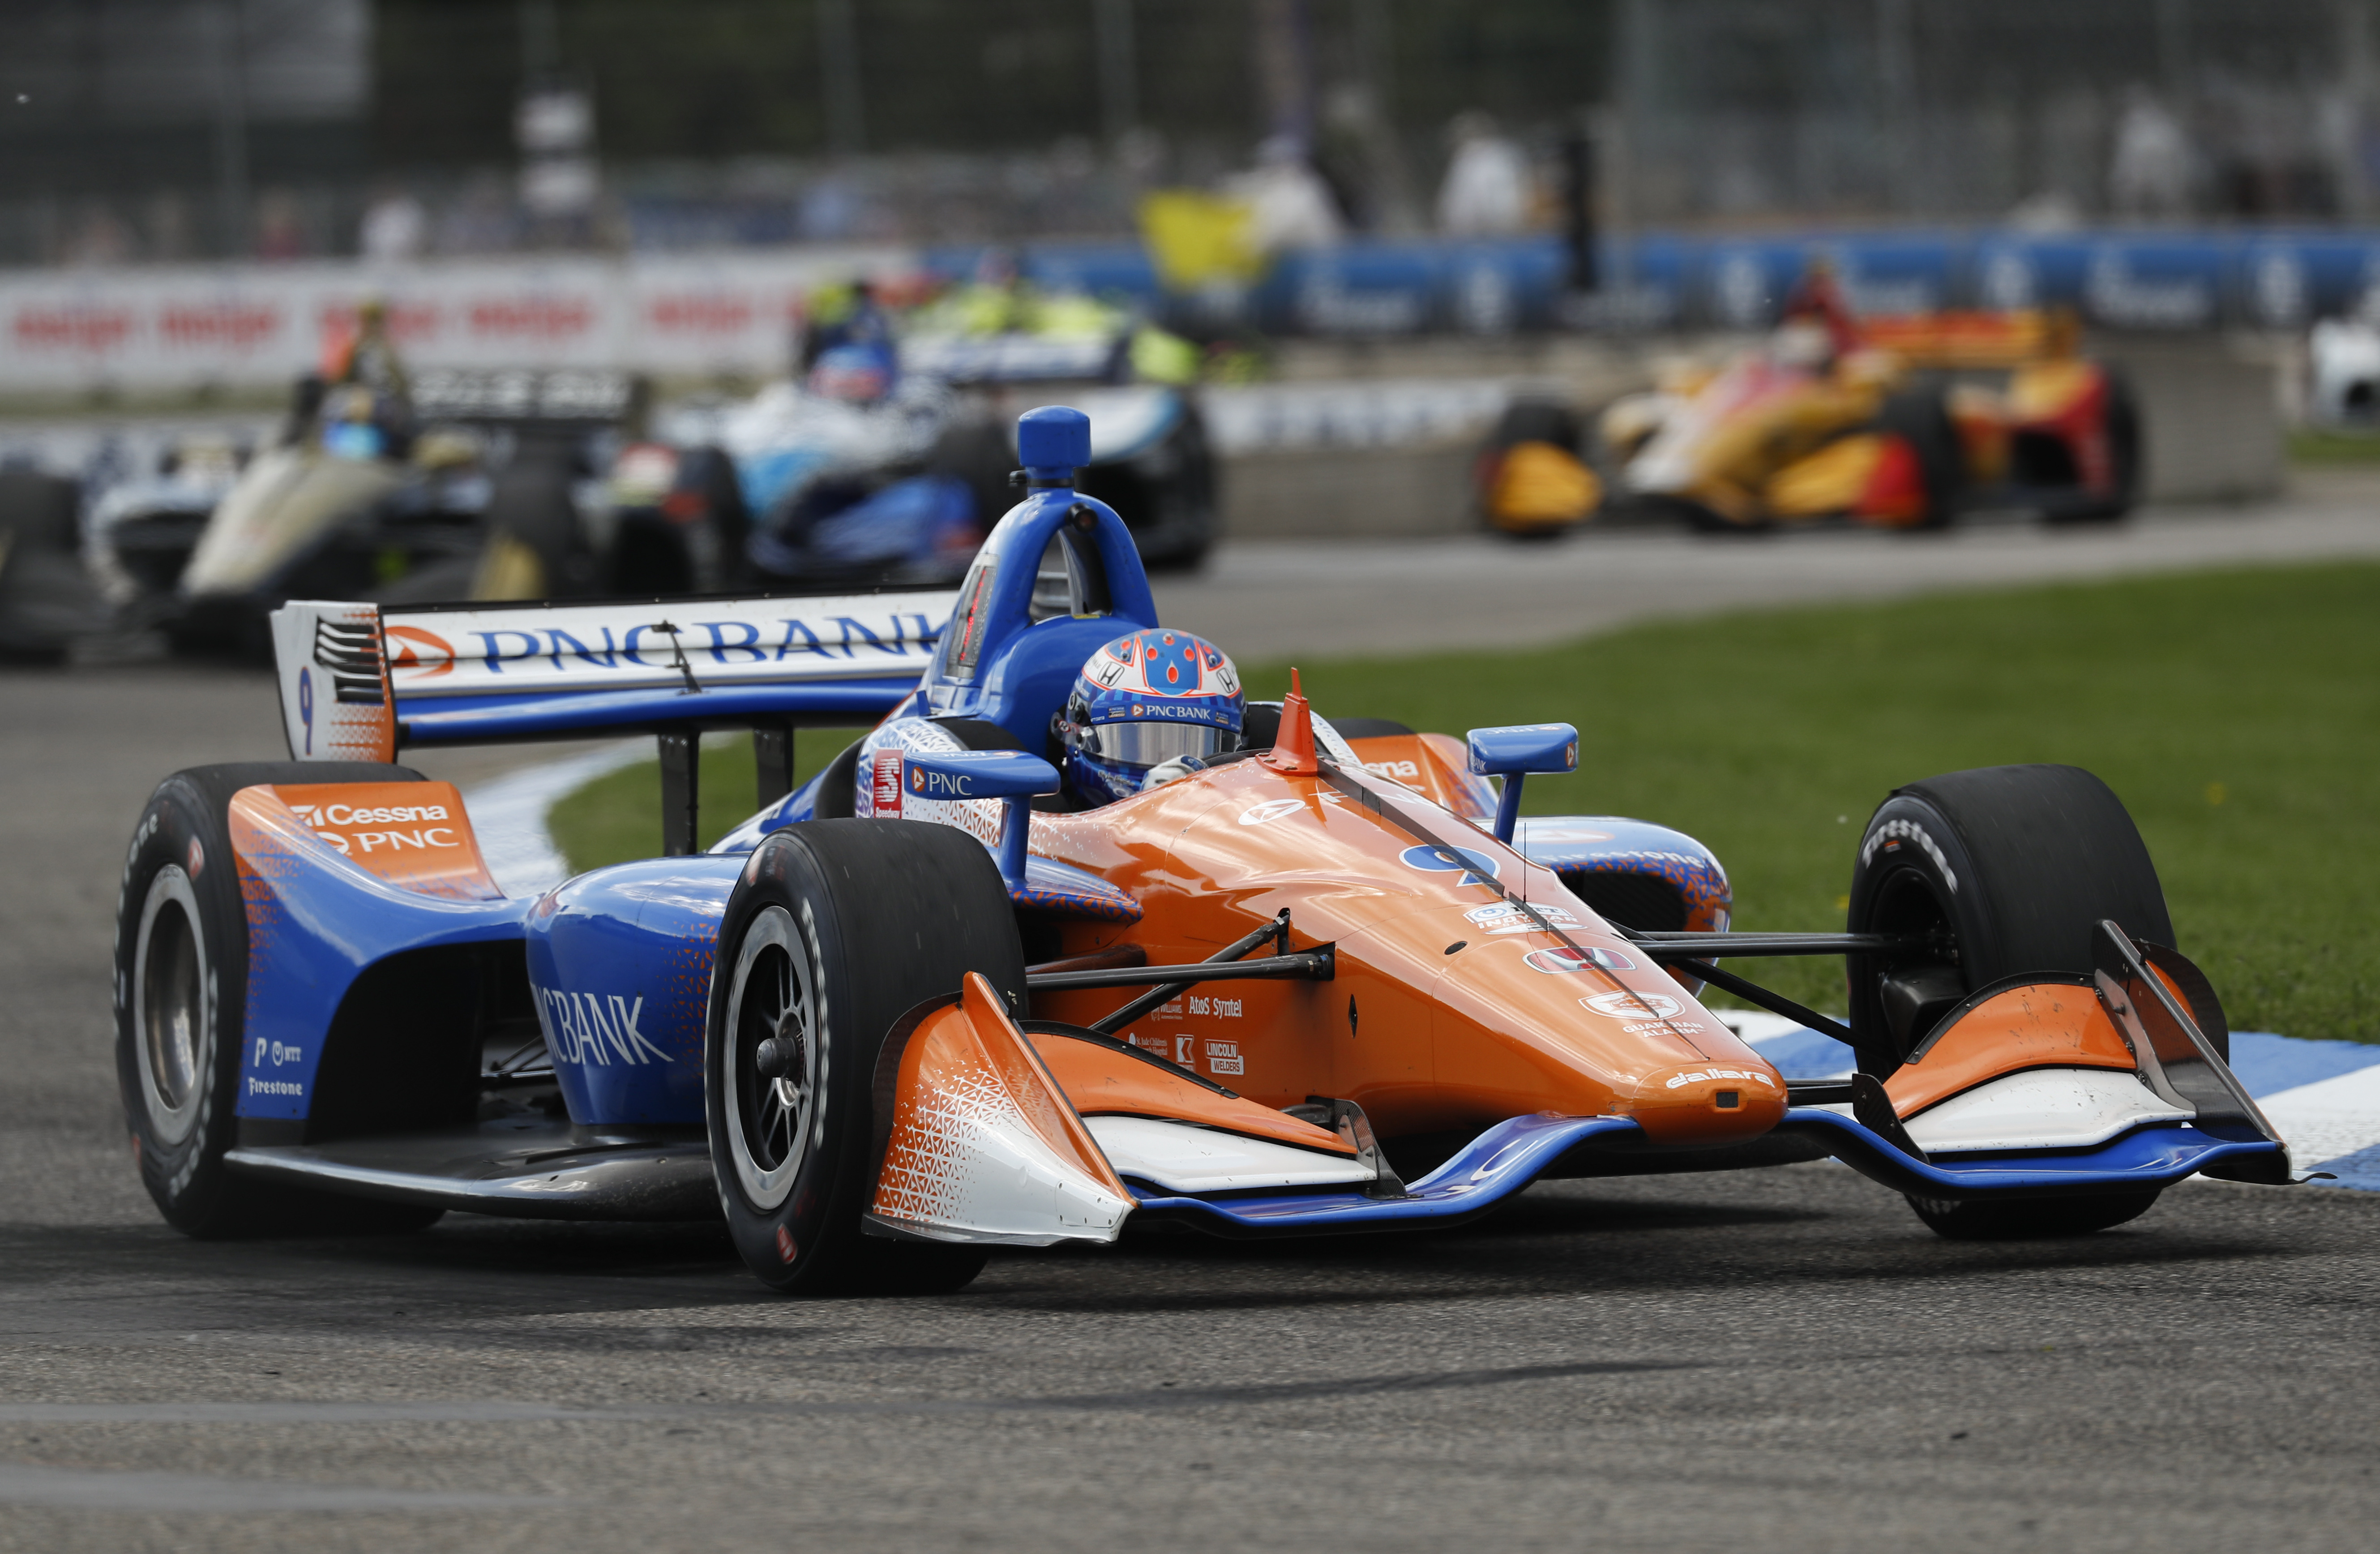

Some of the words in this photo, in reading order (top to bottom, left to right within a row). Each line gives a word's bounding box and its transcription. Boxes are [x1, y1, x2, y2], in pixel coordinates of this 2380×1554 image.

[468, 624, 681, 674] PNC
[299, 665, 312, 756] 9
[1146, 705, 1175, 717] PNC
[1177, 706, 1211, 720] BANK
[927, 771, 972, 796] PNC
[326, 803, 448, 825] Cessna
[875, 807, 901, 819] Speedway
[351, 828, 459, 852] PNC
[1398, 844, 1501, 887] 9
[1213, 998, 1242, 1019] Syntel
[551, 990, 675, 1065] BANK
[1622, 1022, 1704, 1034] GUARDIAN
[284, 1046, 301, 1062] NTT
[1206, 1043, 1237, 1057] LINCOLN
[1213, 1060, 1240, 1072] WELDERS
[248, 1077, 303, 1096] Firestone
[1665, 1068, 1776, 1089] dallara
